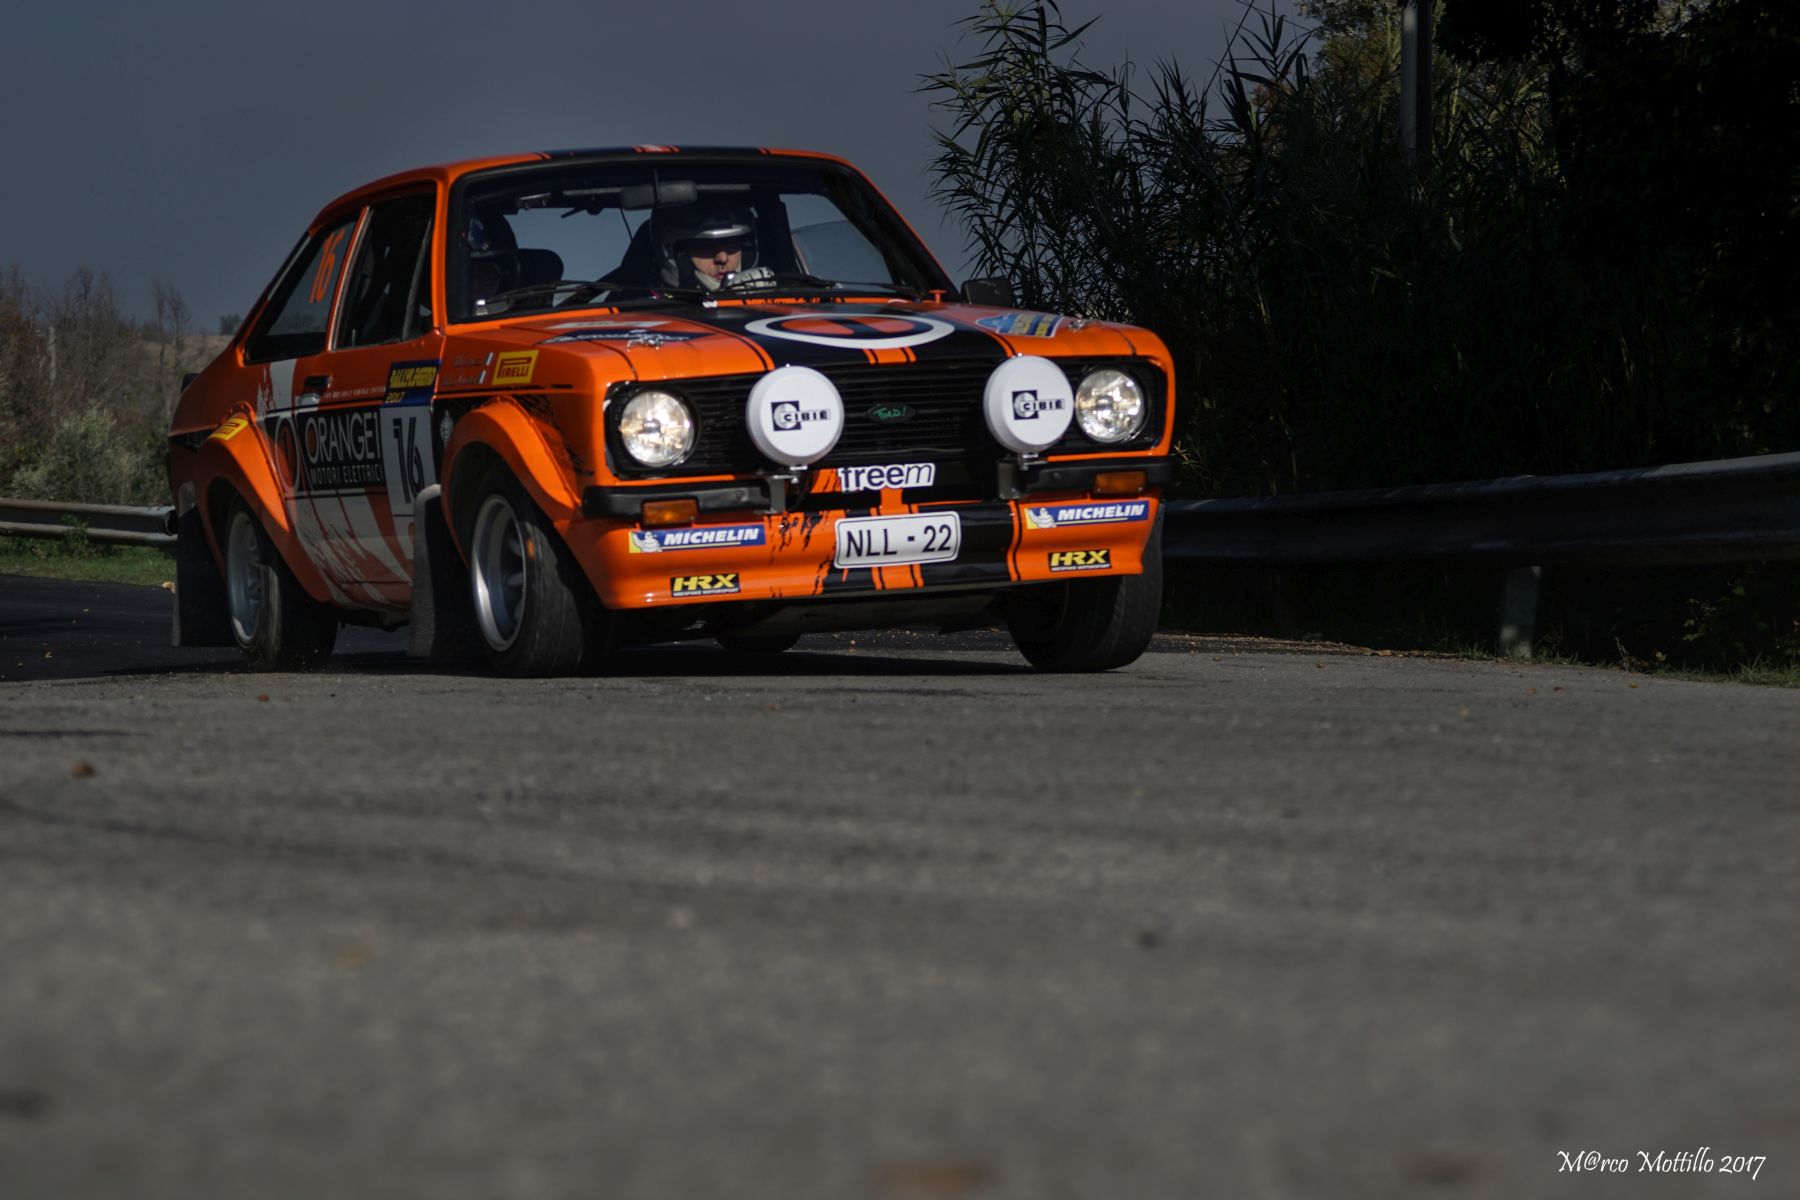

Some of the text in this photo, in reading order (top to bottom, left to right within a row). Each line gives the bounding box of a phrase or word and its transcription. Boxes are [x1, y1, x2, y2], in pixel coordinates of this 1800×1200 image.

[308, 227, 346, 304] 16
[497, 357, 532, 378] PIRELLI
[393, 417, 425, 503] 16
[310, 464, 384, 485] MOTORI ELETTRICI
[841, 465, 932, 489] freem
[1057, 504, 1145, 521] MICHELIN
[663, 528, 760, 545] MICHELIN
[846, 529, 897, 557] NLL
[922, 525, 952, 552] 22
[1050, 549, 1108, 567] HRX
[672, 574, 737, 592] HRX
